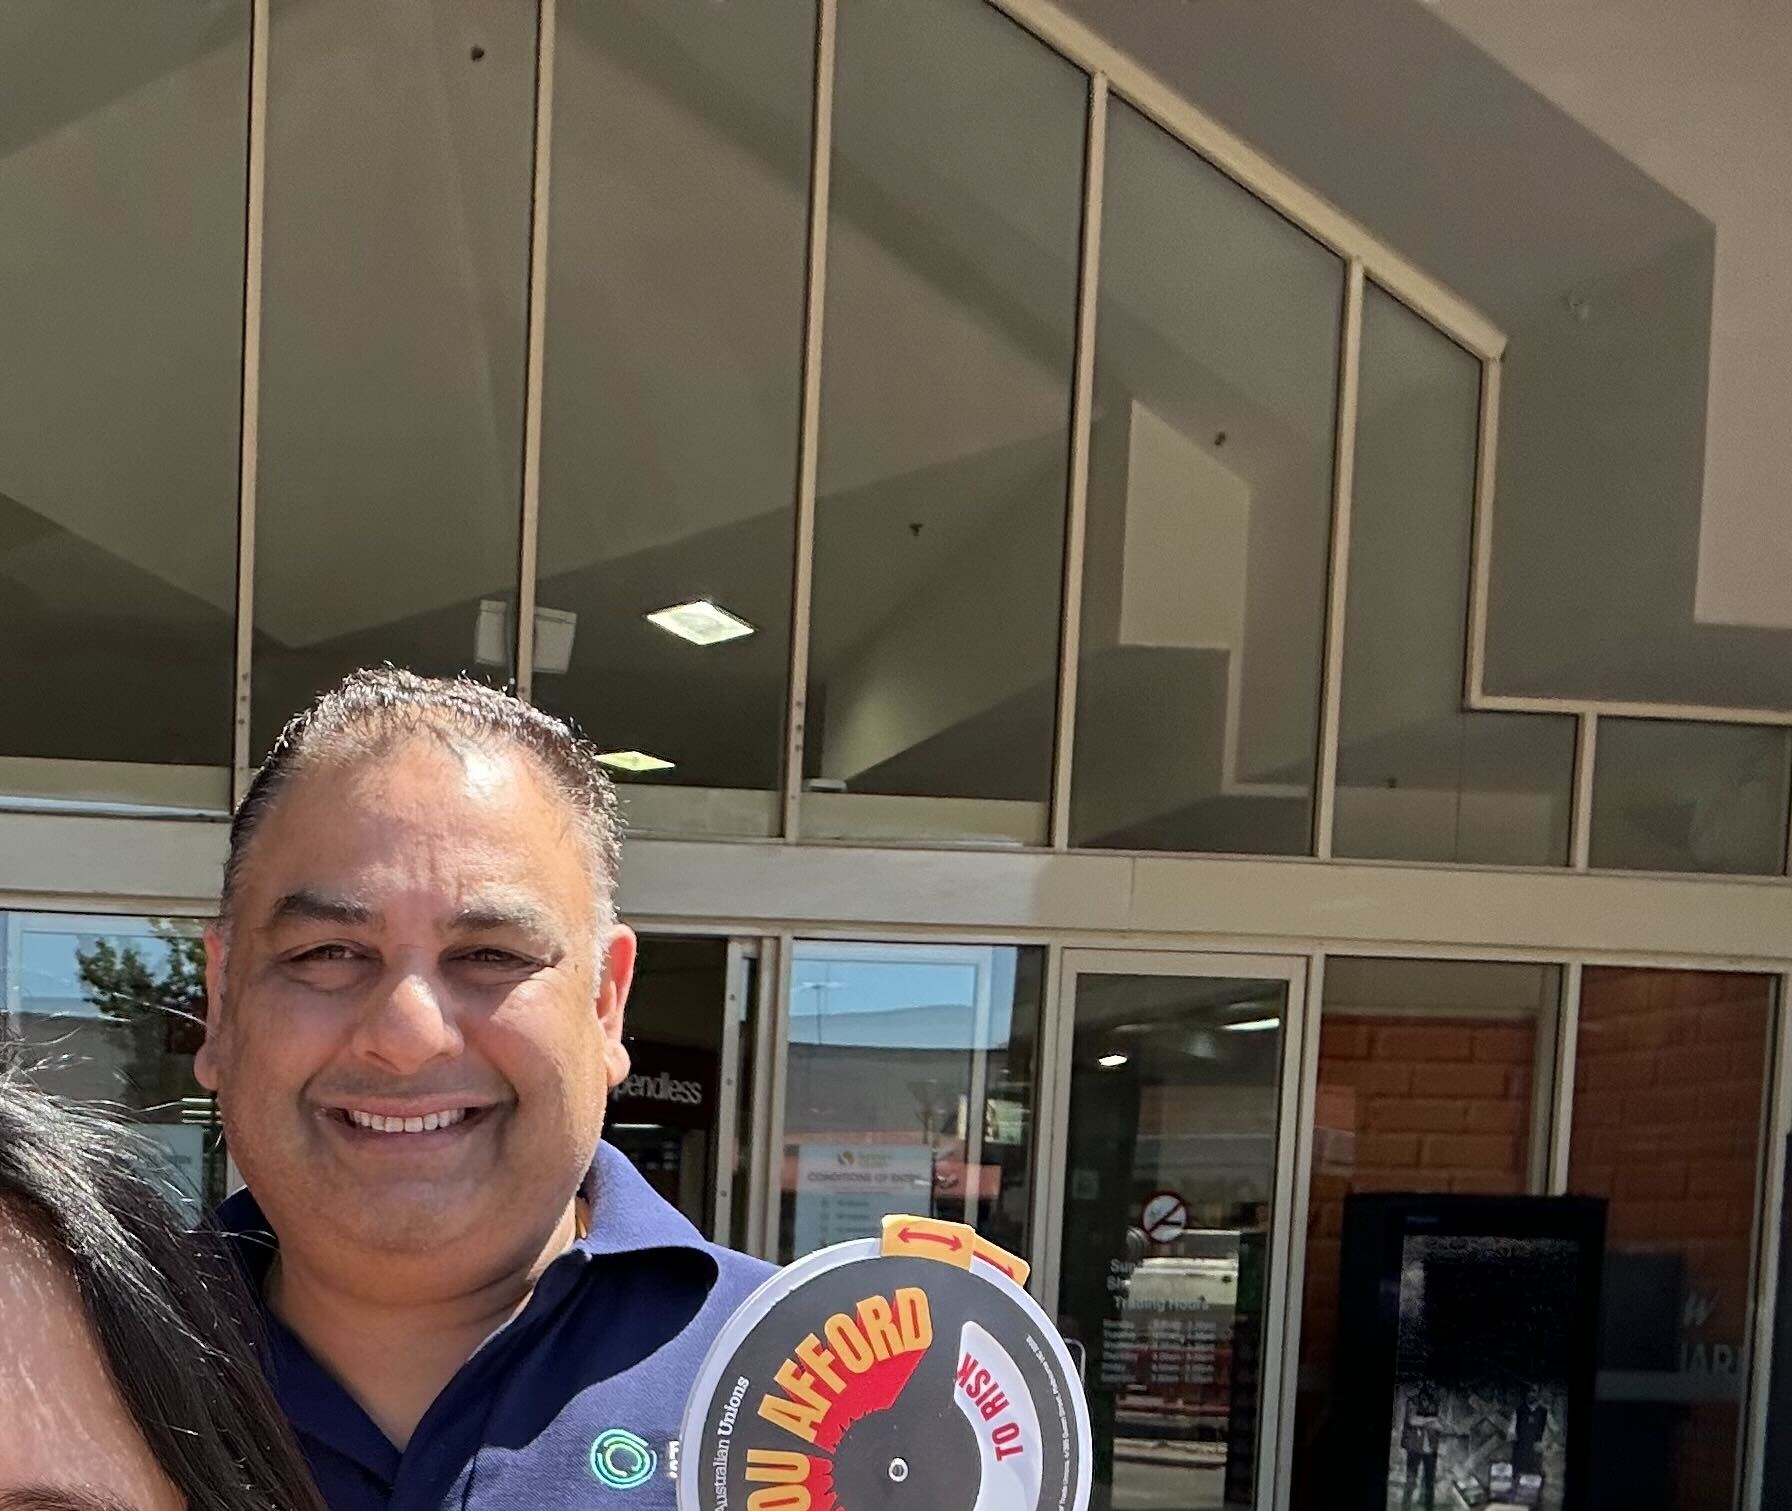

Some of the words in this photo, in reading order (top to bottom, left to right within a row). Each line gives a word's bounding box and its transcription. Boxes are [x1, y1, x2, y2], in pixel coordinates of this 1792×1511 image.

[610, 1071, 703, 1104] pendless
[757, 1286, 933, 1443] AFFORD
[955, 1352, 1010, 1422] RISK
[717, 1375, 750, 1436] Unions
[991, 1422, 1024, 1462] TO
